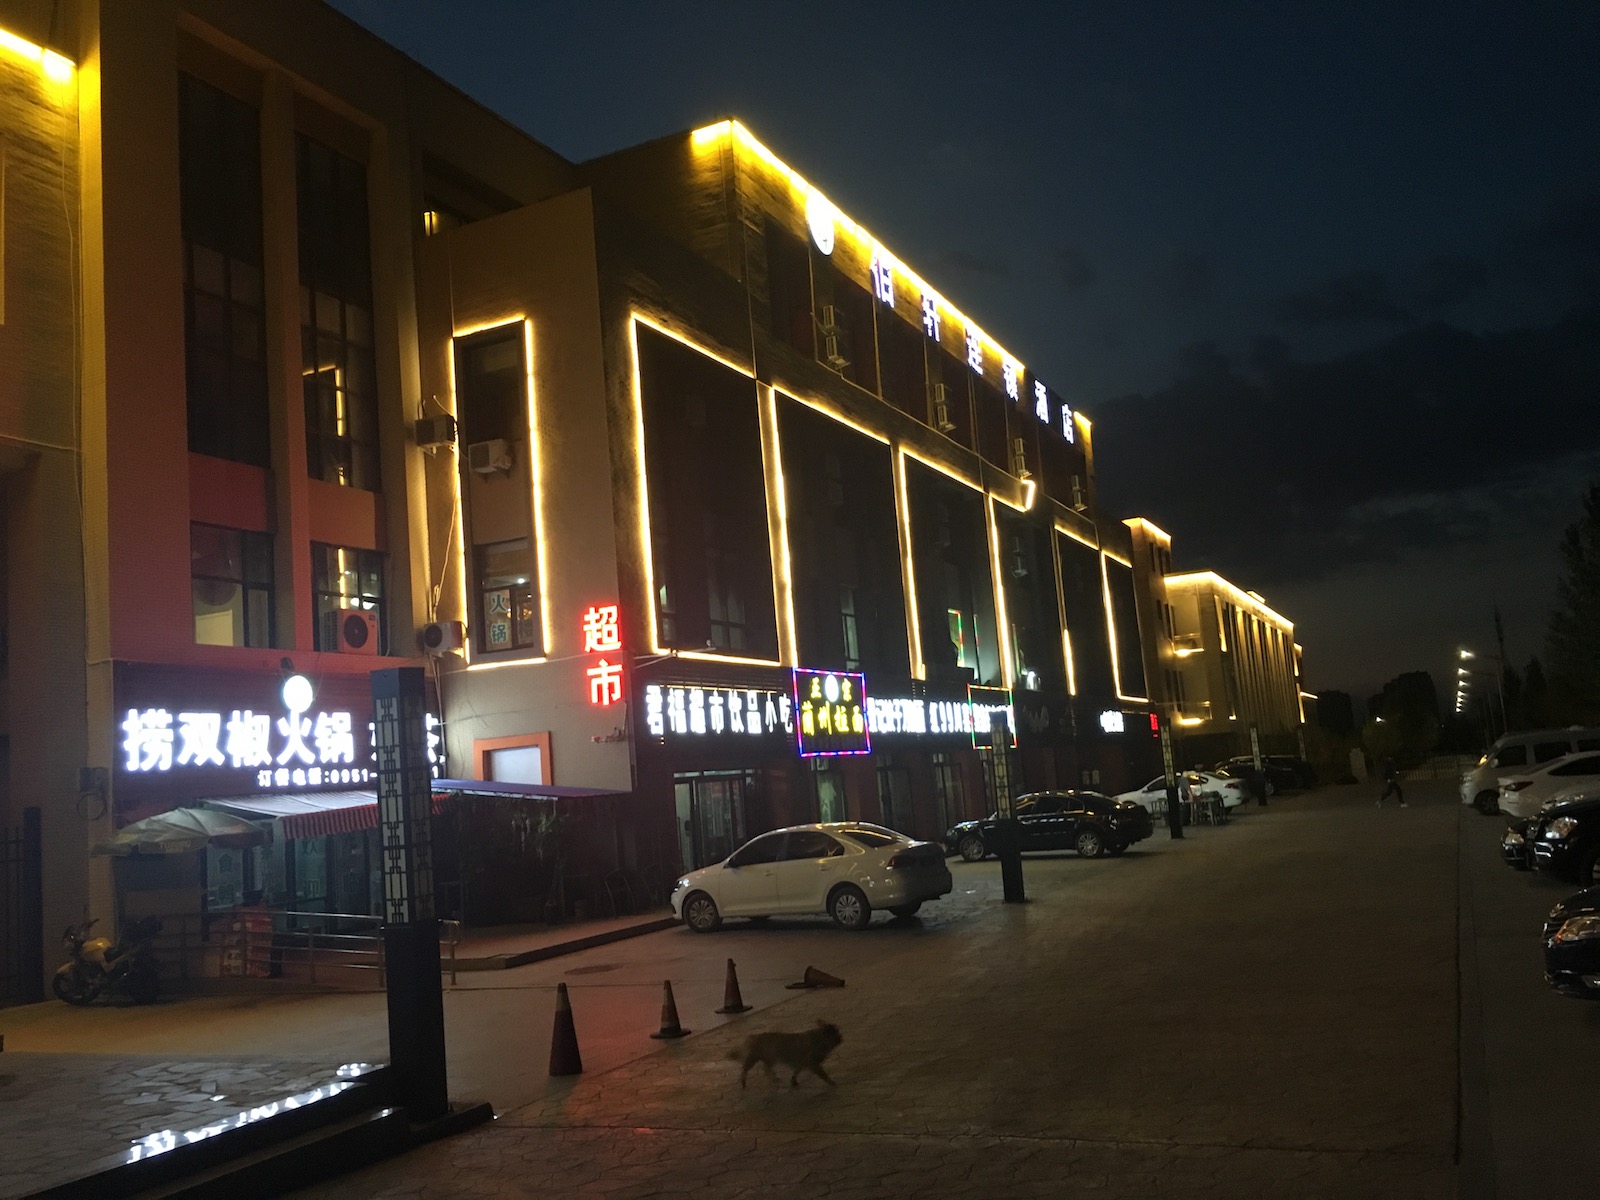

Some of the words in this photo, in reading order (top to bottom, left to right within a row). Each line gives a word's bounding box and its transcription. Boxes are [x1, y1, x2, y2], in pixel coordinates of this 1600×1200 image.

[490, 594, 507, 644] 火锅
[583, 605, 623, 706] 超市
[122, 707, 354, 771] 捞双椒火锅
